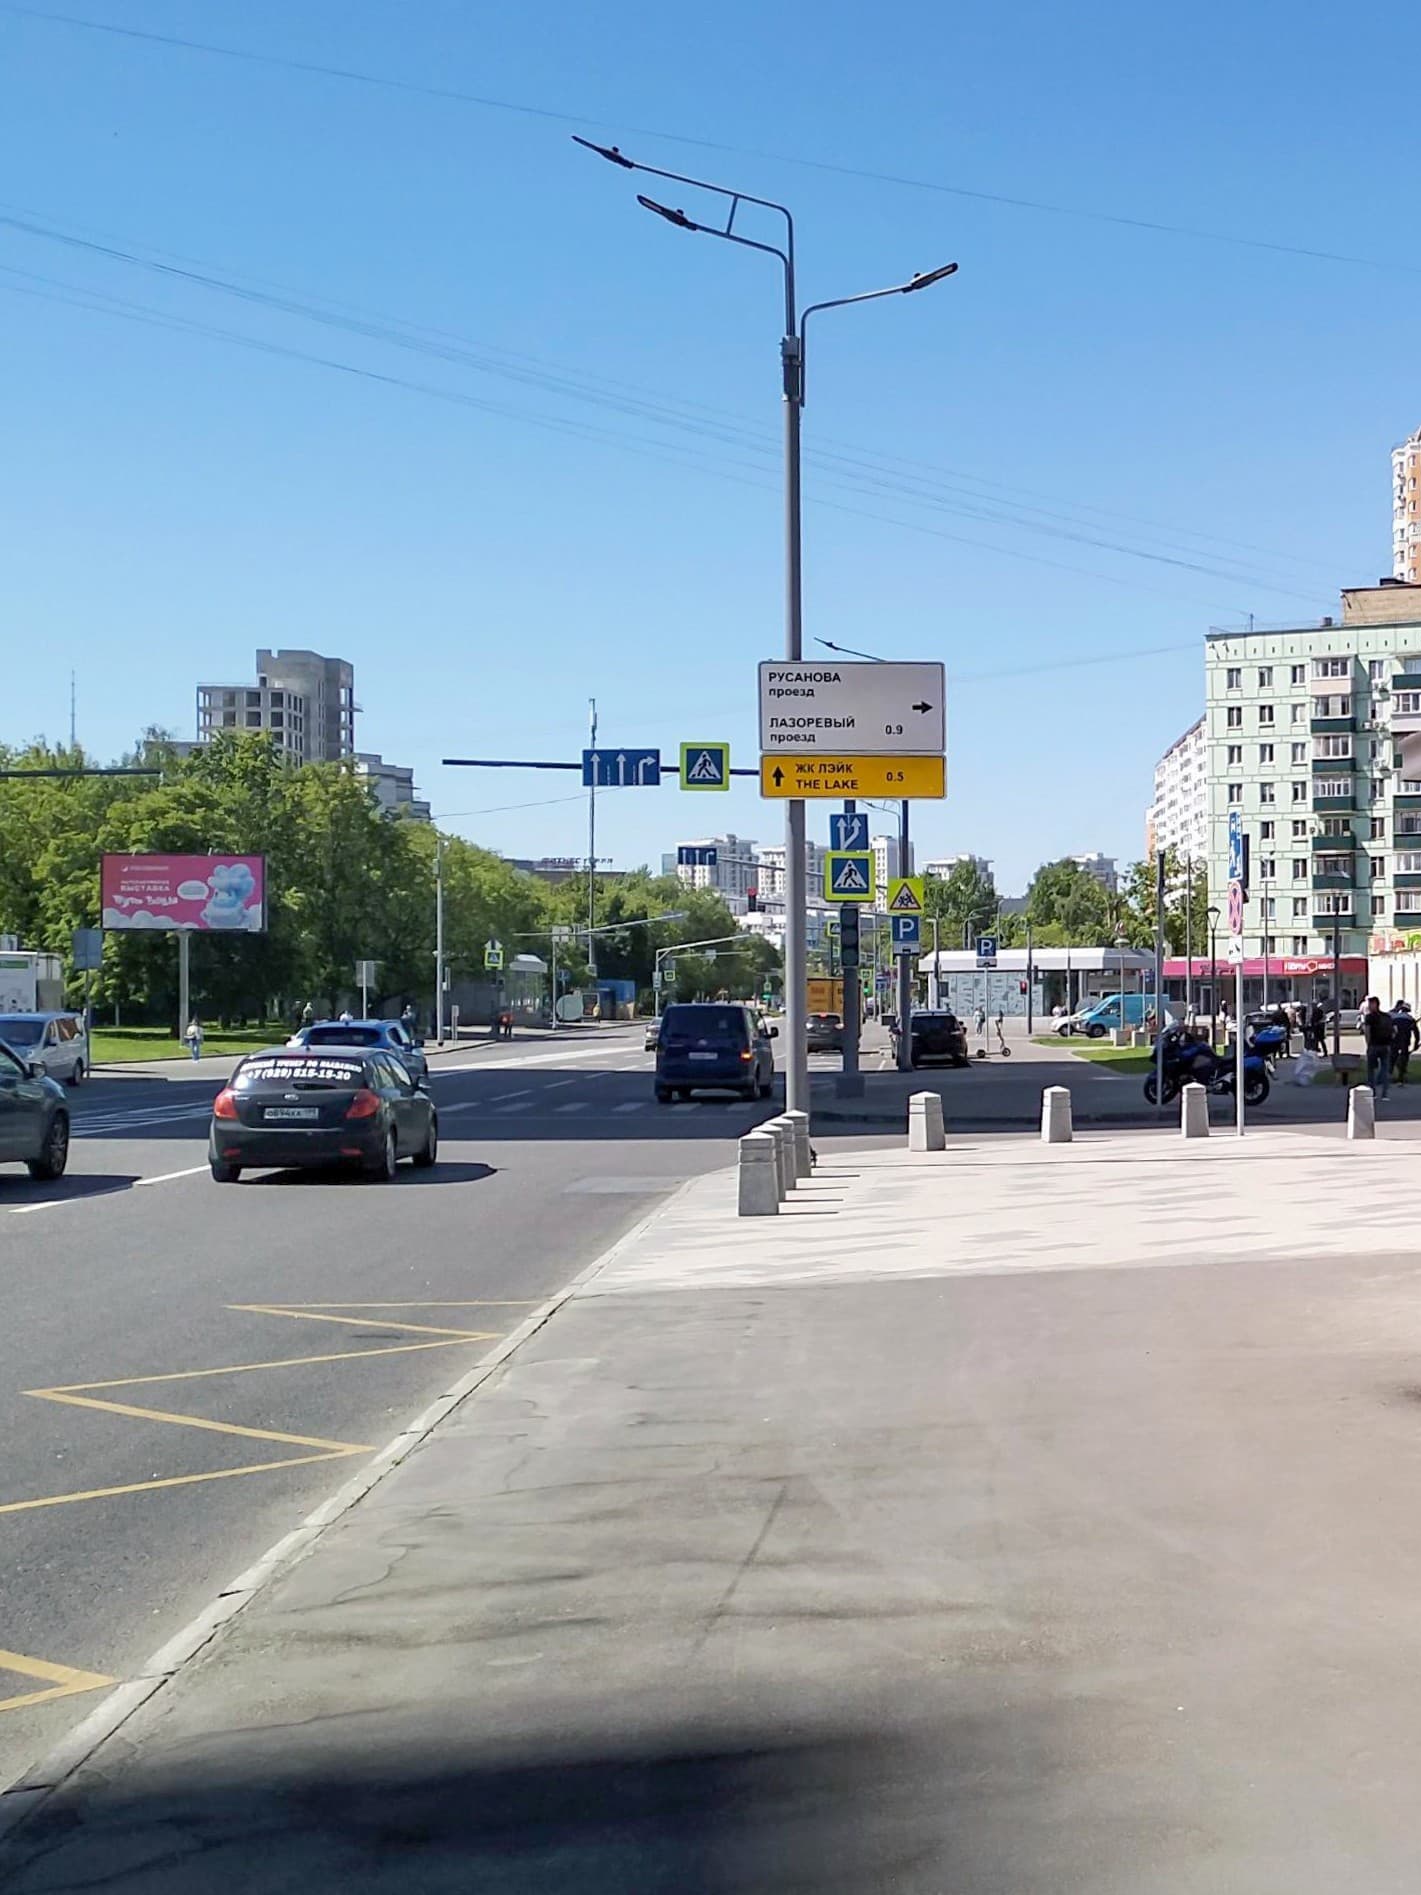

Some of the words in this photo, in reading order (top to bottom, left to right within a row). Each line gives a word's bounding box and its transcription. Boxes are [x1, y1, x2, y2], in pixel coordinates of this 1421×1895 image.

[768, 672, 841, 683] РУСАНОВА
[768, 687, 815, 698] проезд
[769, 715, 855, 728] ЛАЗОРЕВЫЙ
[885, 725, 903, 735] 0.9
[770, 733, 816, 744] проезд
[796, 763, 814, 774] ЖК
[818, 762, 853, 774] ЛЭЙК
[886, 772, 904, 782] 0.5
[796, 779, 820, 790] THE
[824, 779, 859, 790] LAKE
